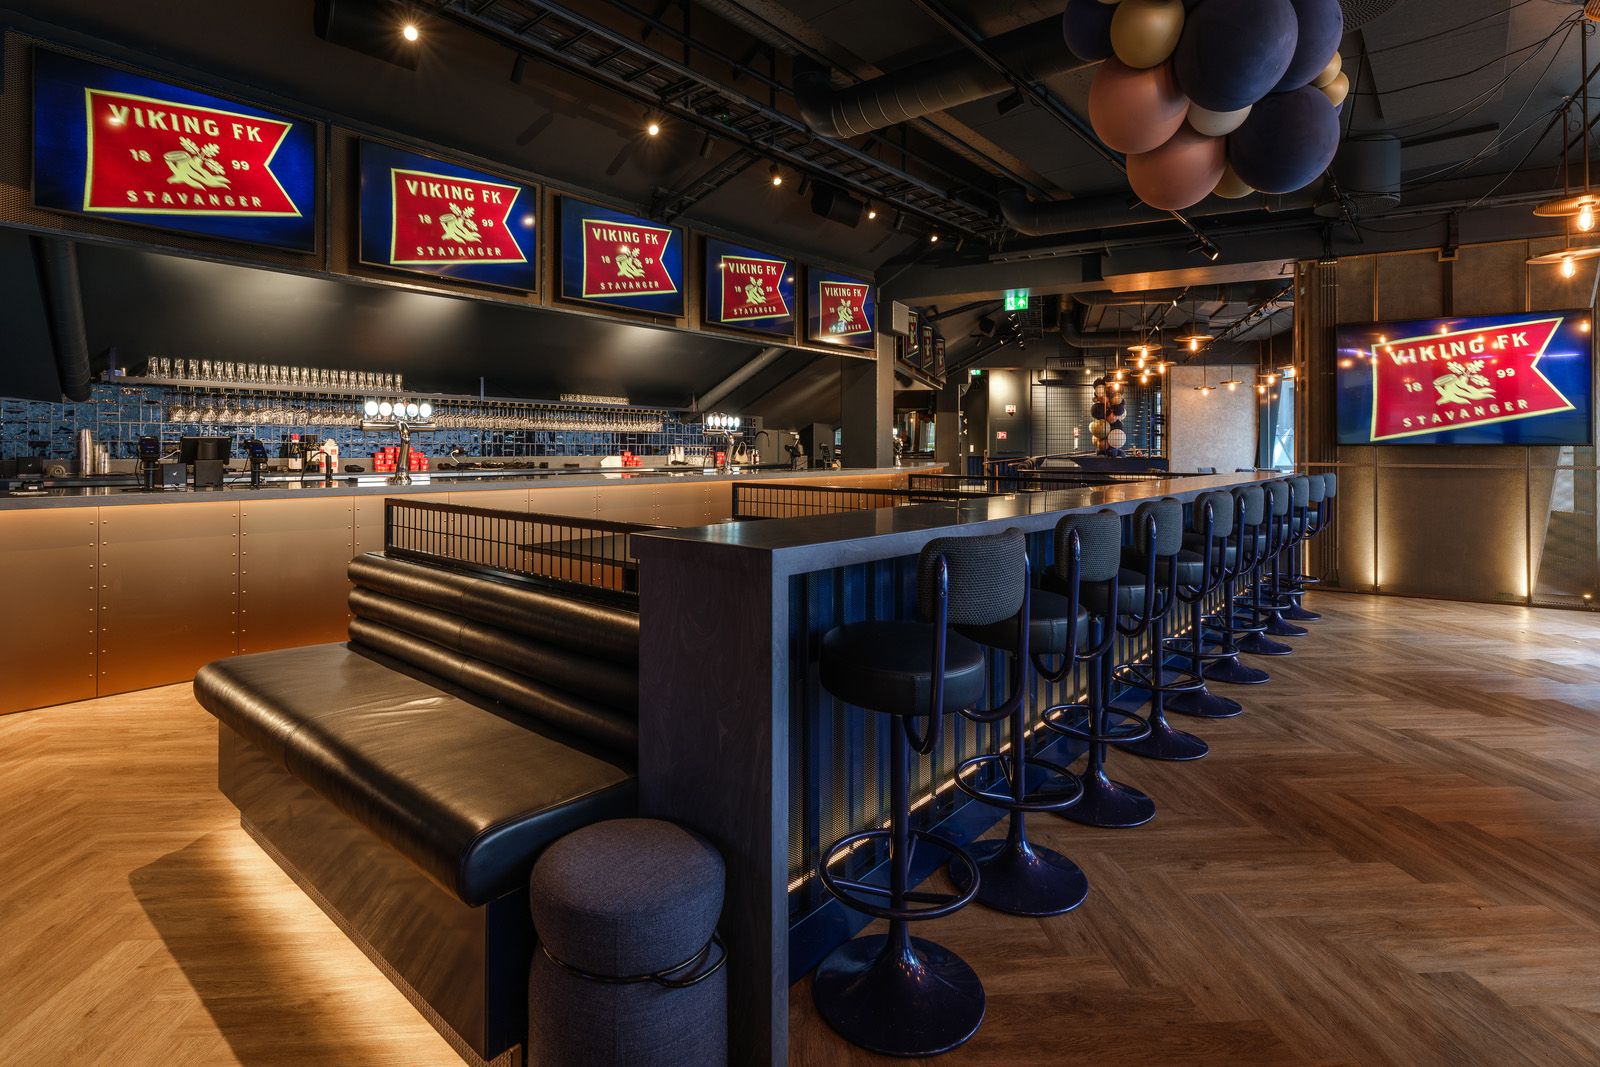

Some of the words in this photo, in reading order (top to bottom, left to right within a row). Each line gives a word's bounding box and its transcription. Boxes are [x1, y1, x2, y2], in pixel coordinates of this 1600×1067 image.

[108, 103, 220, 137] VIKING
[231, 122, 263, 143] FK
[129, 148, 153, 163] 18
[232, 159, 250, 171] 99
[126, 189, 262, 208] STAVANGER
[405, 179, 475, 201] VIKING
[482, 189, 502, 204] FK
[417, 213, 432, 225] 18
[481, 218, 494, 227] 99
[592, 227, 640, 243] VIKING
[644, 232, 659, 245] FK
[416, 246, 502, 257] STAVANGER
[601, 255, 611, 264] 18
[728, 262, 763, 275] VIKING
[766, 265, 777, 276] FK
[600, 280, 660, 290] STAVANGER
[824, 287, 851, 297] VIKING
[853, 288, 862, 297] FK
[733, 305, 777, 316] STAVANGER
[1388, 337, 1485, 366] VIKING
[1496, 331, 1529, 350] FK
[1404, 381, 1423, 393] 18
[1496, 367, 1516, 379] 99
[1402, 398, 1529, 428] STAVANGER
